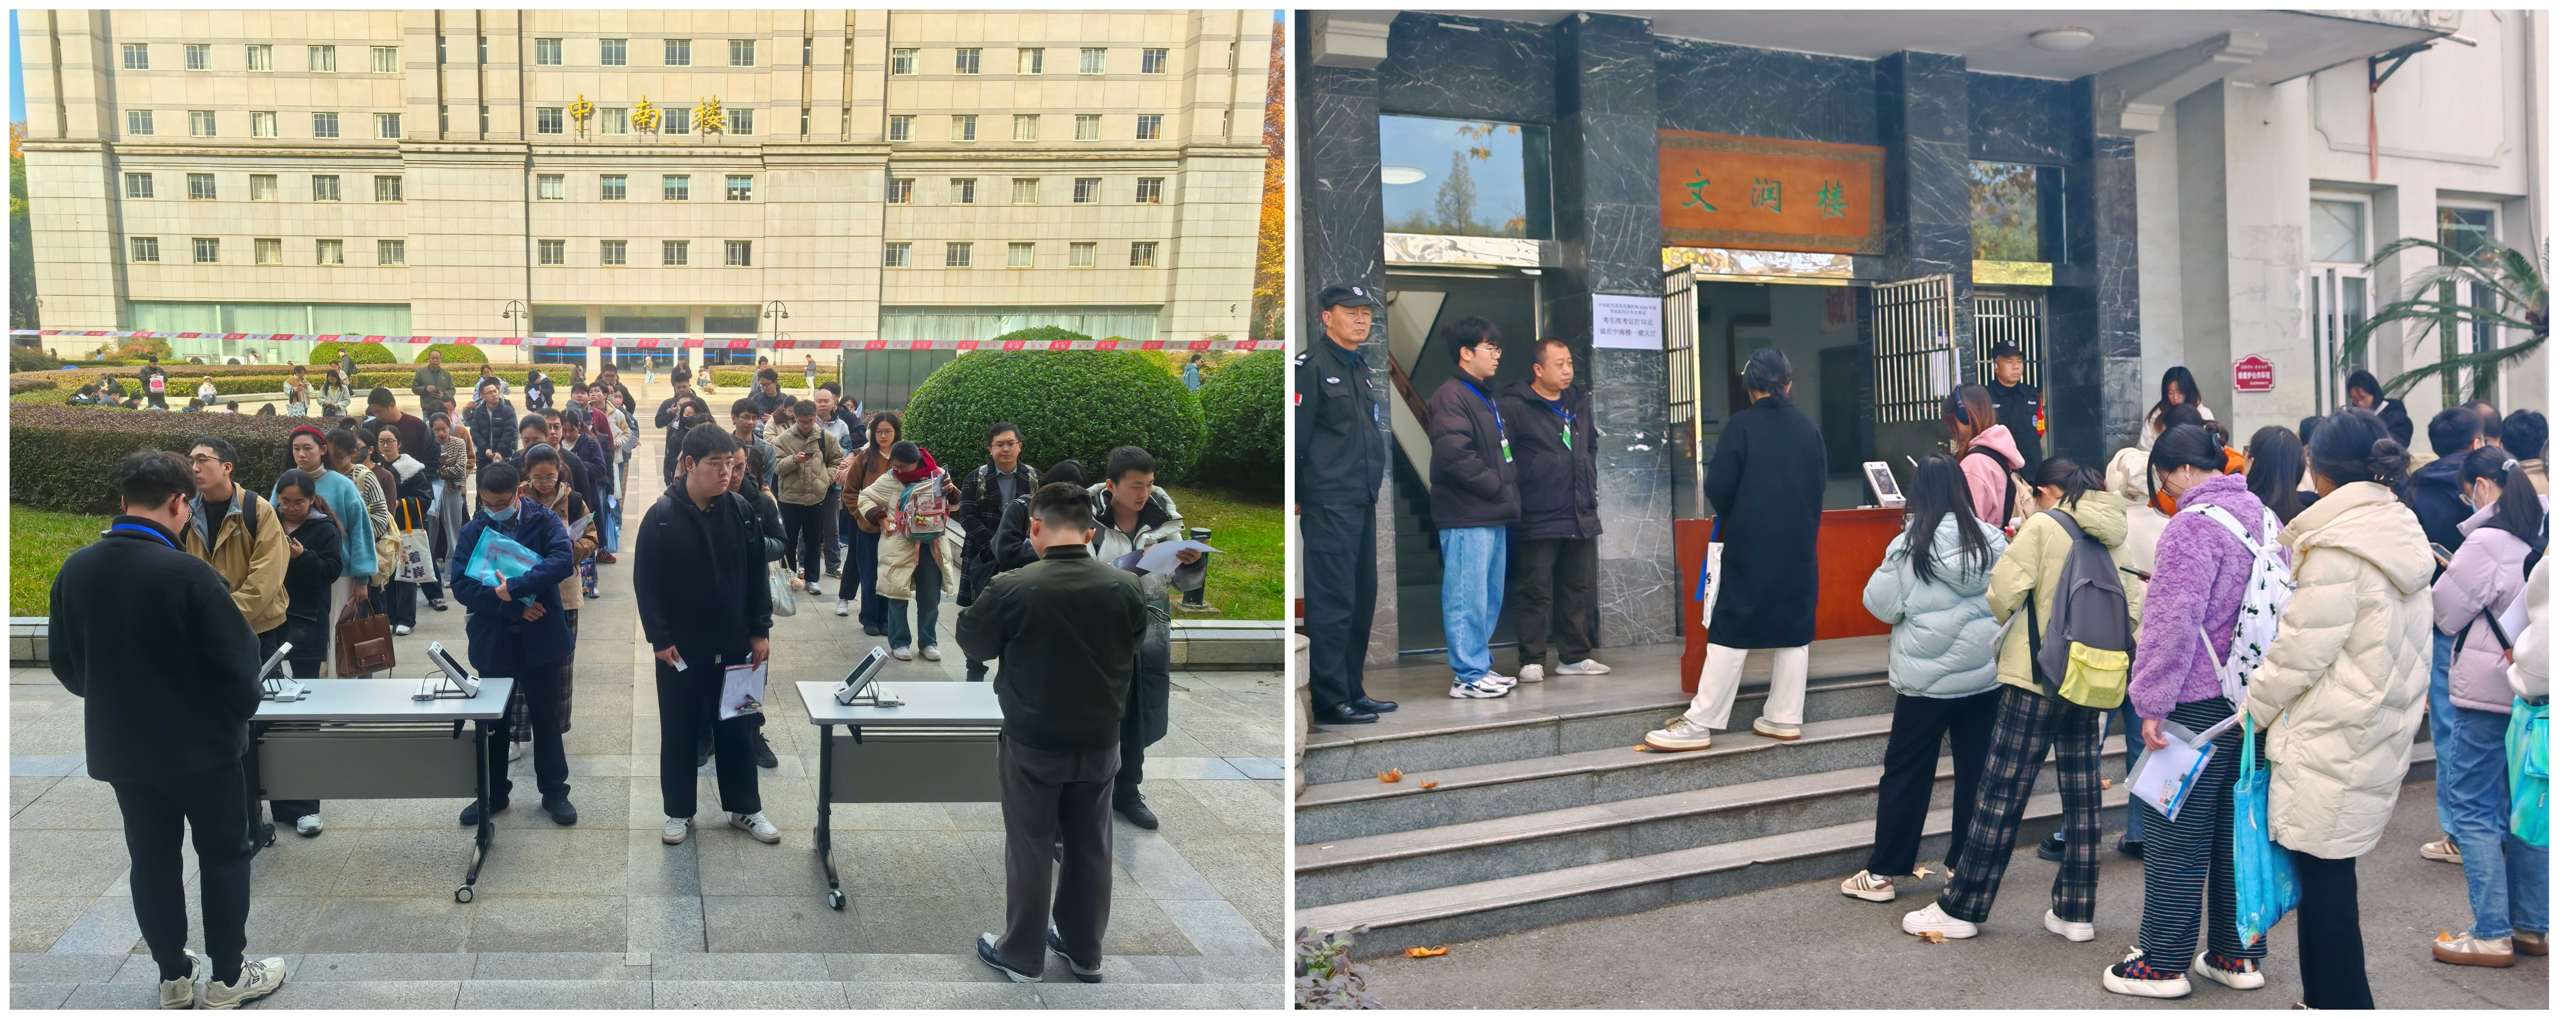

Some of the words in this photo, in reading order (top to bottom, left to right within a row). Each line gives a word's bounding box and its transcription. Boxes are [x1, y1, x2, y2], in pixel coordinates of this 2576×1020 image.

[568, 93, 726, 133] 中南楼
[1681, 168, 1849, 218] 文润楼
[1603, 317, 1653, 326] 考生准考证打印点
[1600, 327, 1657, 337] 设在中南楼一楼大厅
[408, 551, 420, 564] 着
[400, 566, 425, 578] 上岸
